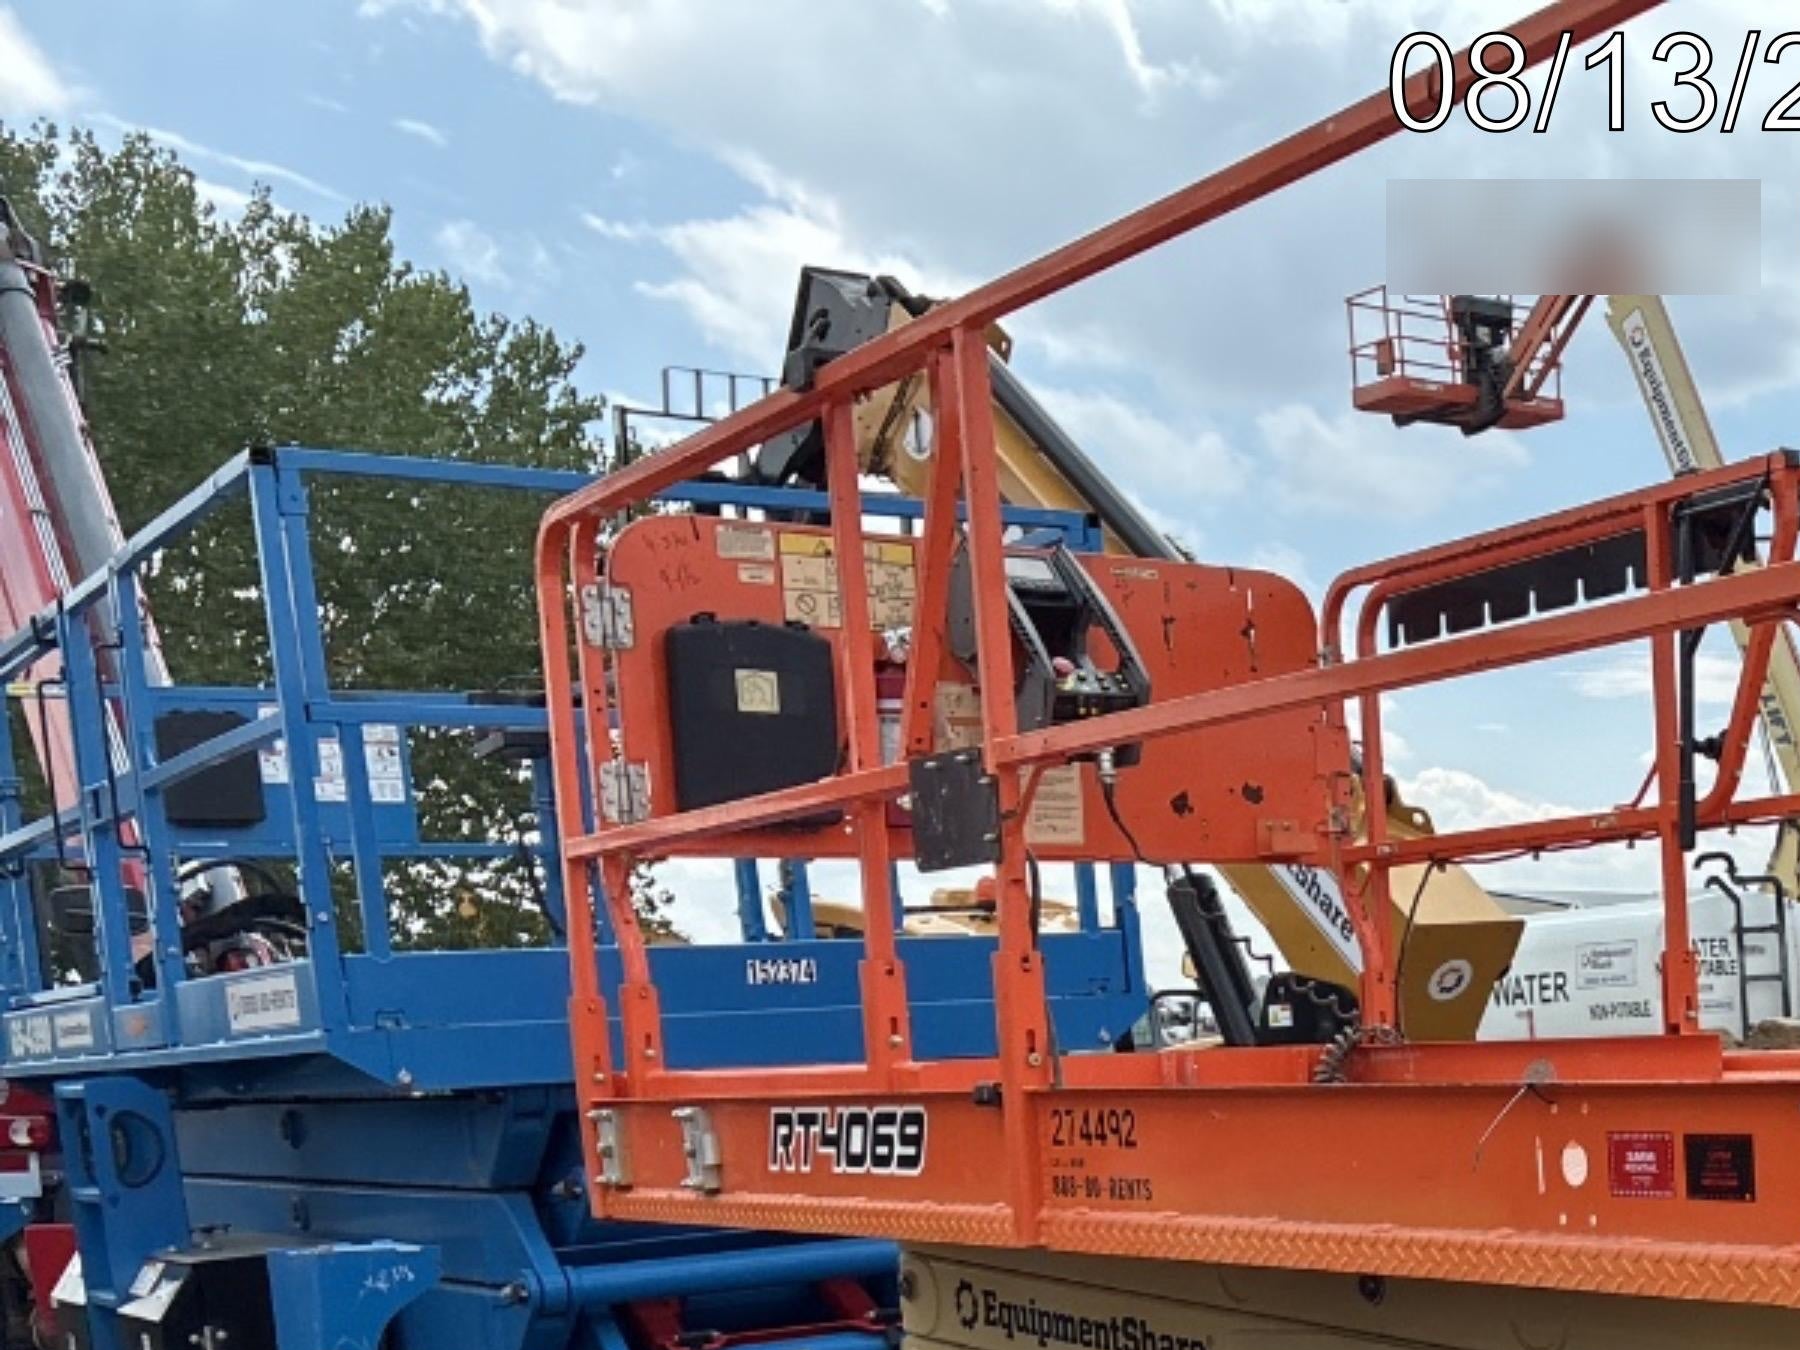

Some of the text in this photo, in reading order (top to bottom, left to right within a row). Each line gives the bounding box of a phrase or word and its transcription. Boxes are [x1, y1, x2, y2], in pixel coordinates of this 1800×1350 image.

[1690, 938, 1731, 959] ATER
[1493, 971, 1570, 1008] WATER
[768, 1104, 929, 1177] RT4069
[1051, 1108, 1138, 1149] 274492
